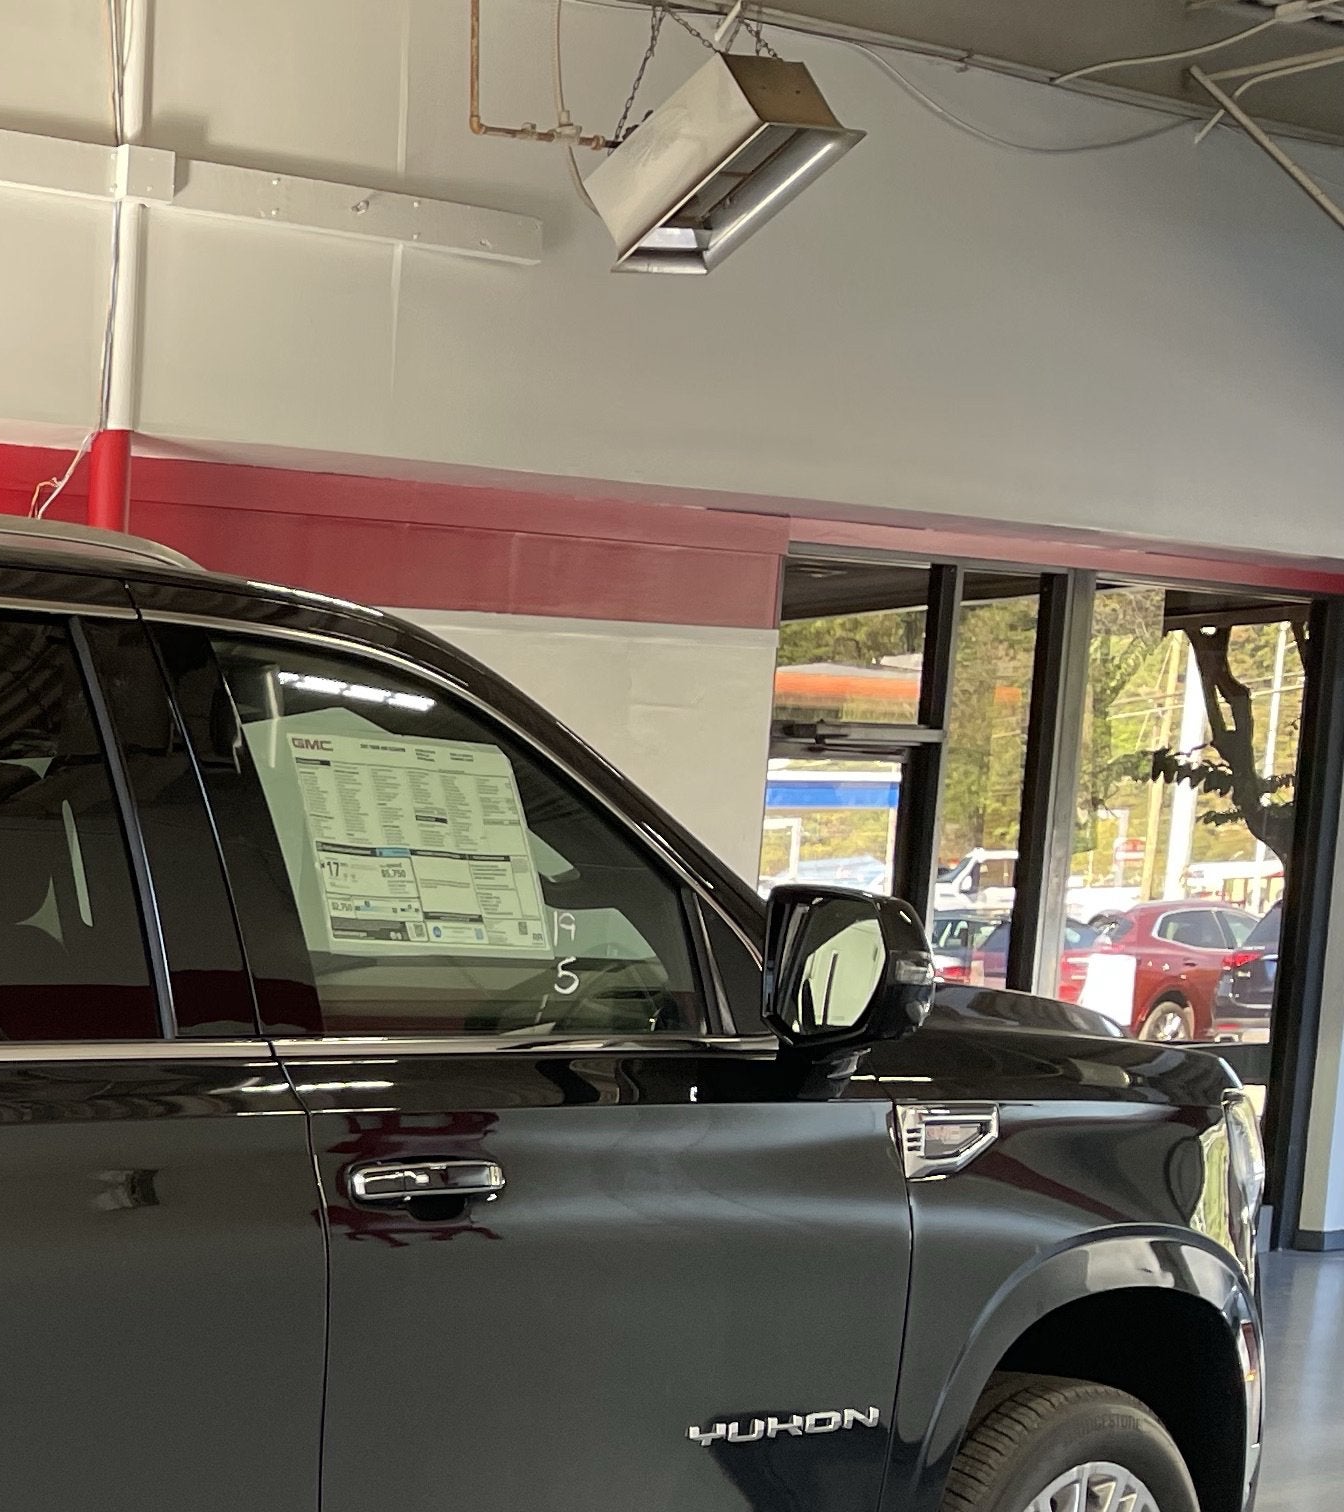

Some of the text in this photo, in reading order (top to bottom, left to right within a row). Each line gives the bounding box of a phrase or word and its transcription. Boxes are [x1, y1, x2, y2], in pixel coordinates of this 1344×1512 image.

[291, 737, 334, 752] GMC
[554, 956, 580, 995] 5
[686, 1406, 880, 1447] YUKON
